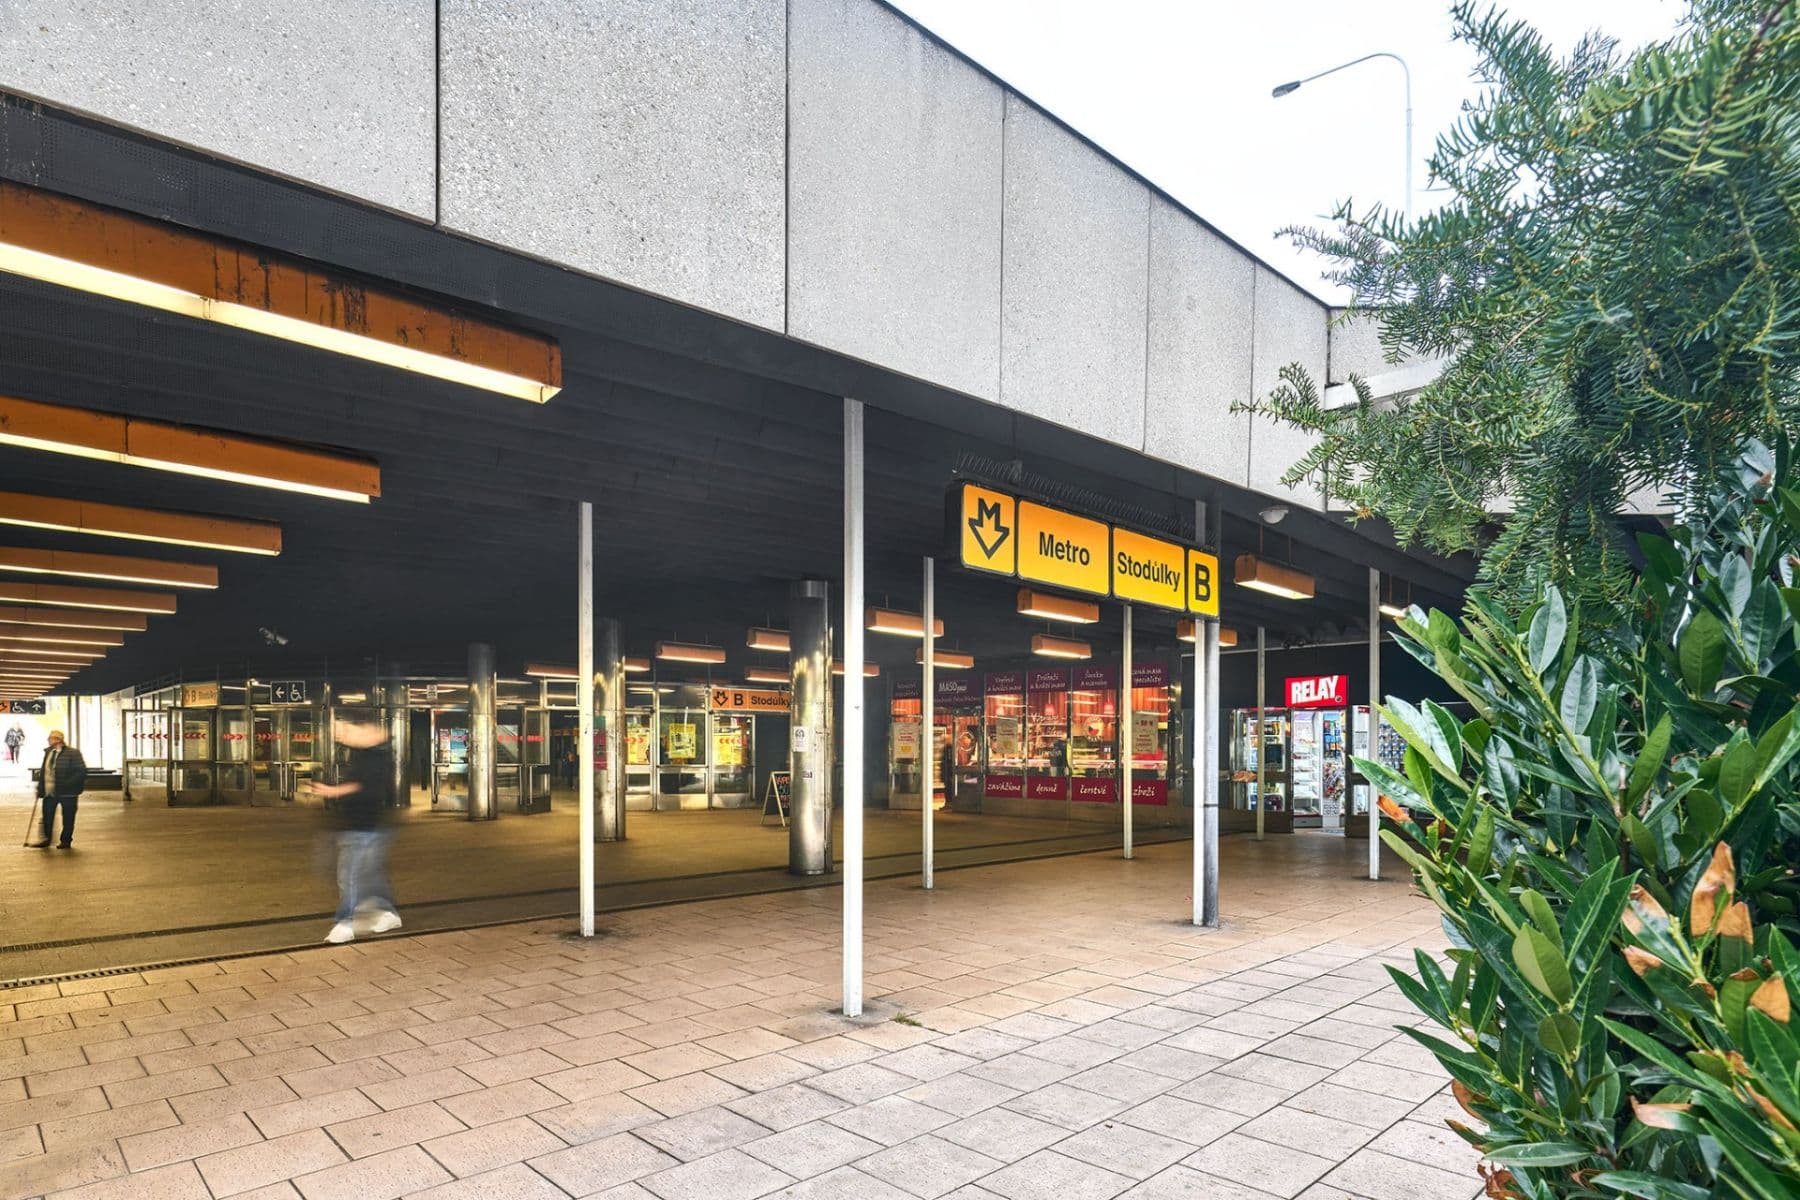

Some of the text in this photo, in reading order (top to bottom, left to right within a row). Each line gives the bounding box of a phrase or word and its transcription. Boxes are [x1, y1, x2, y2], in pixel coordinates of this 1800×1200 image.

[1039, 531, 1090, 566] Metro
[1195, 563, 1211, 602] B
[734, 693, 744, 706] B
[1291, 675, 1339, 704] RELAY
